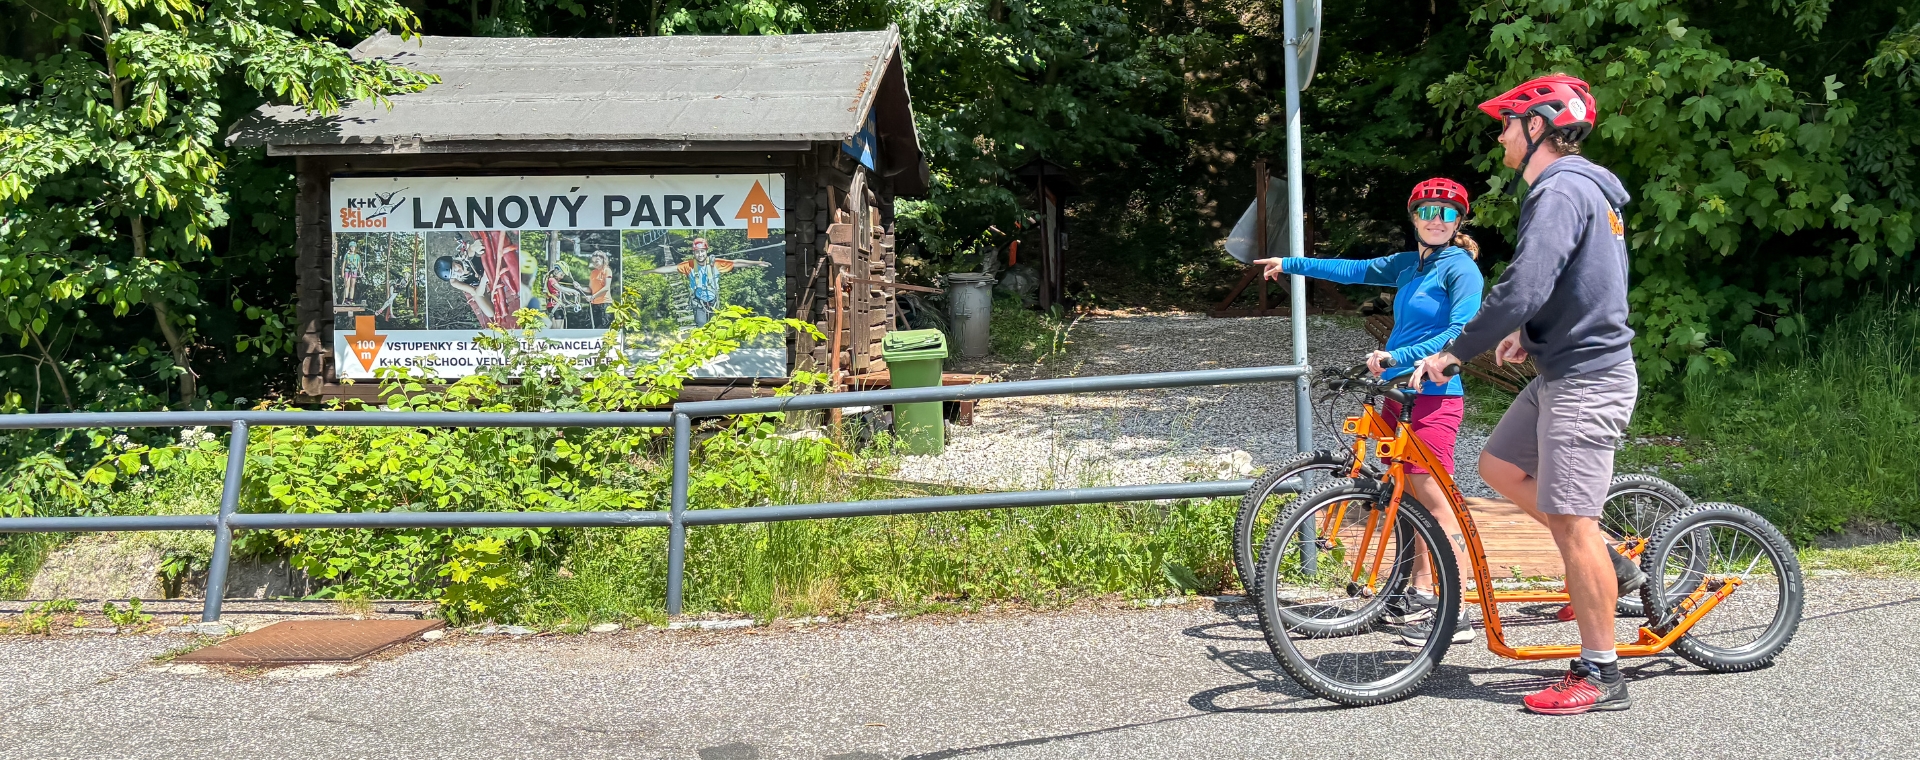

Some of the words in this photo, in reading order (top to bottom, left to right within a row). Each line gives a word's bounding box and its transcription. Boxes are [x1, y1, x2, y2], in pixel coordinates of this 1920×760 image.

[347, 197, 377, 209] K+K
[412, 186, 589, 230] LANOVÝ
[603, 193, 726, 228] PARK
[750, 203, 765, 214] 50
[339, 206, 362, 220] Ski
[341, 217, 387, 229] School
[751, 215, 763, 225] m
[356, 340, 376, 350] 100
[386, 341, 453, 351] VSTUPENKY
[456, 341, 468, 351] SI
[360, 351, 372, 360] m
[379, 357, 402, 367] K+K
[426, 357, 474, 367] SCHOOL
[1744, 520, 1797, 593] SCHWALBE
[1302, 667, 1379, 697] SCHWALBE
